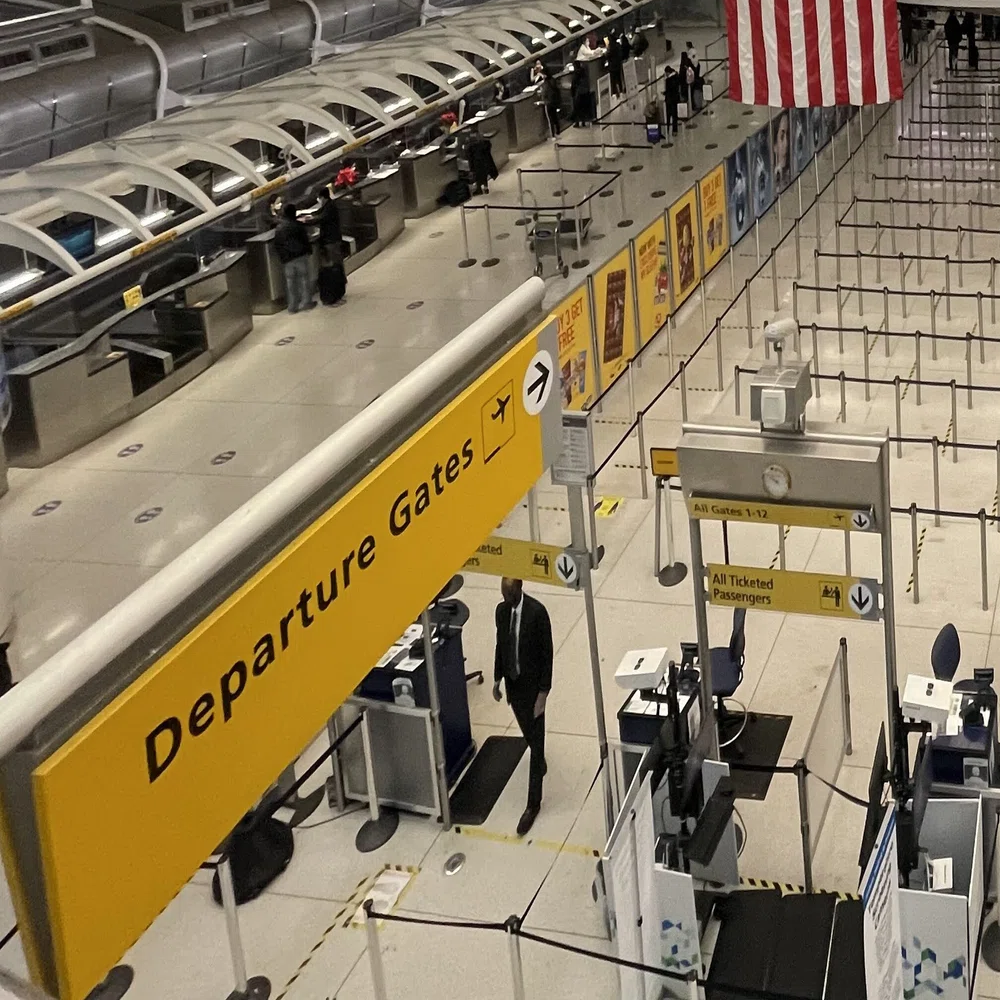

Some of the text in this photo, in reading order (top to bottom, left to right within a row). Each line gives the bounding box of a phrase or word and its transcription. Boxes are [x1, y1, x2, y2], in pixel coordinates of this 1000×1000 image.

[571, 297, 583, 320] GET
[558, 324, 576, 352] FREE
[694, 503, 768, 519] All Gates 1-12
[713, 573, 774, 591] All Ticketed
[713, 588, 771, 606] Passengers
[143, 436, 474, 785] Departure Gates
